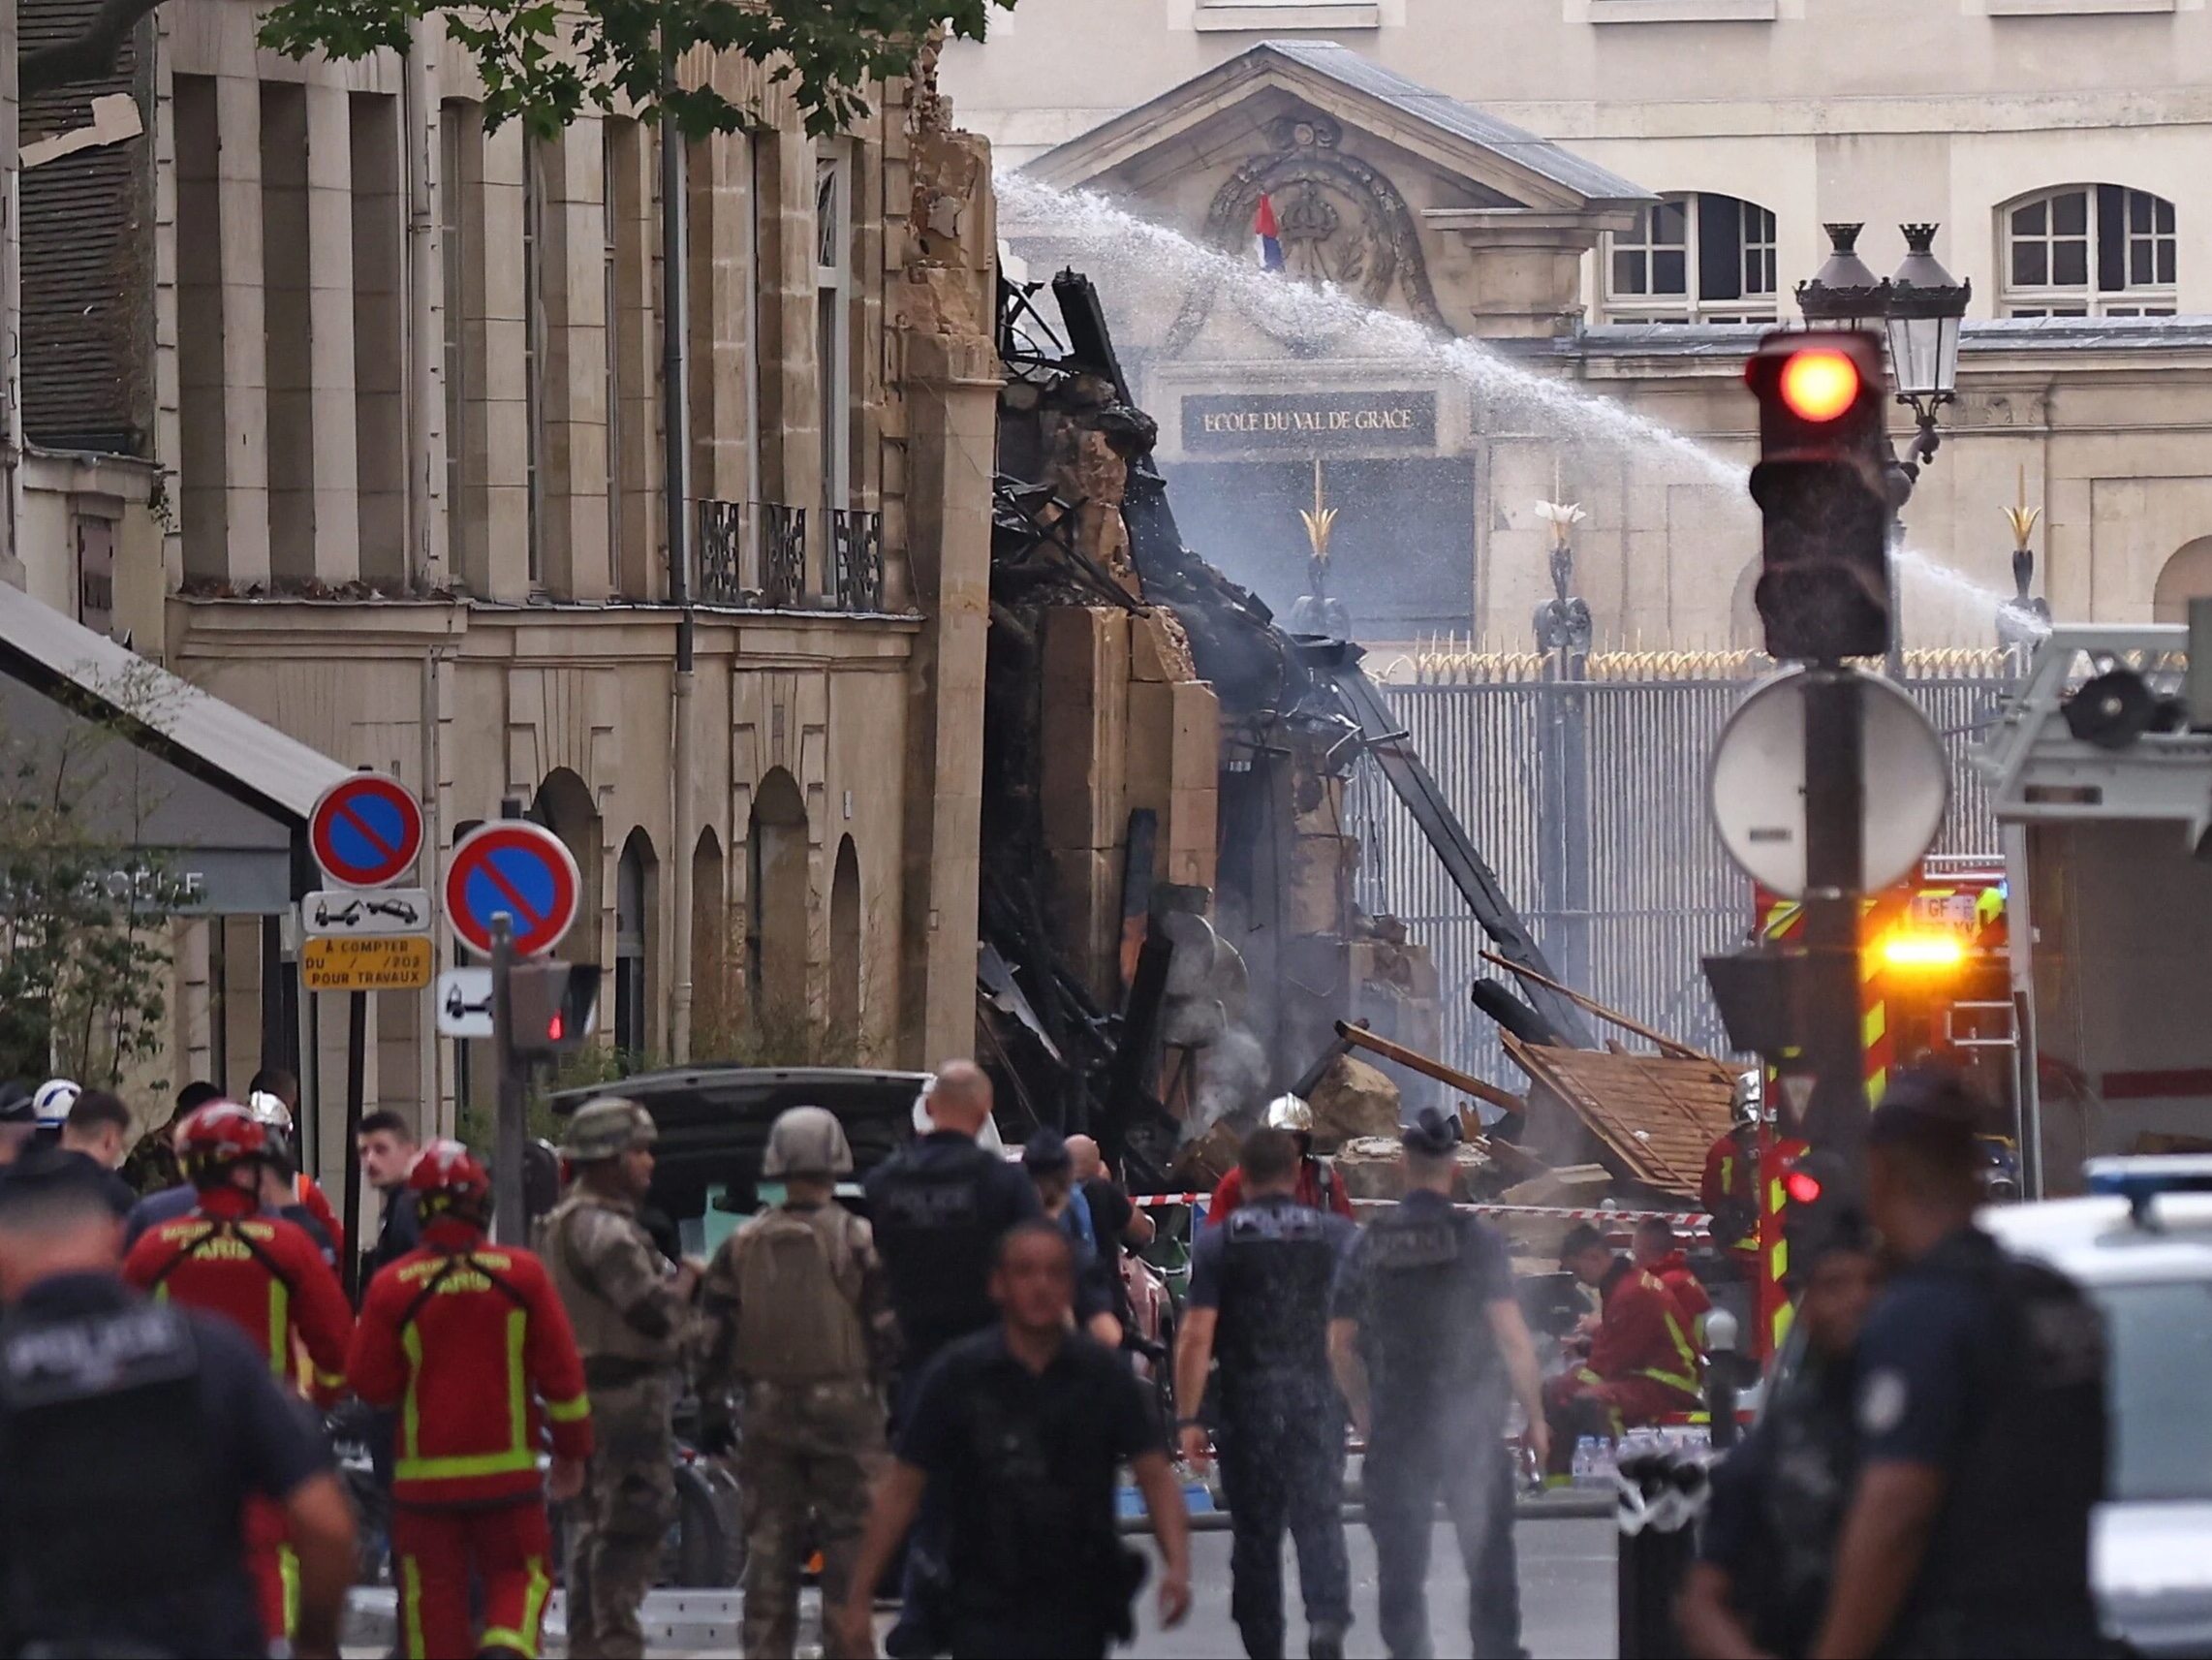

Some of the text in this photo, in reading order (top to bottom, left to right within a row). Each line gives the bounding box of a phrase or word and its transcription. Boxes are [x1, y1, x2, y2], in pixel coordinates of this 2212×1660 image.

[1204, 412, 1260, 432] ECOLE
[1263, 411, 1290, 430] DU
[1293, 411, 1326, 430] VAL
[1328, 410, 1351, 429] DE
[341, 941, 408, 953] COMPTER
[306, 957, 325, 969] DU
[312, 970, 419, 985] POUR TRAVAUX
